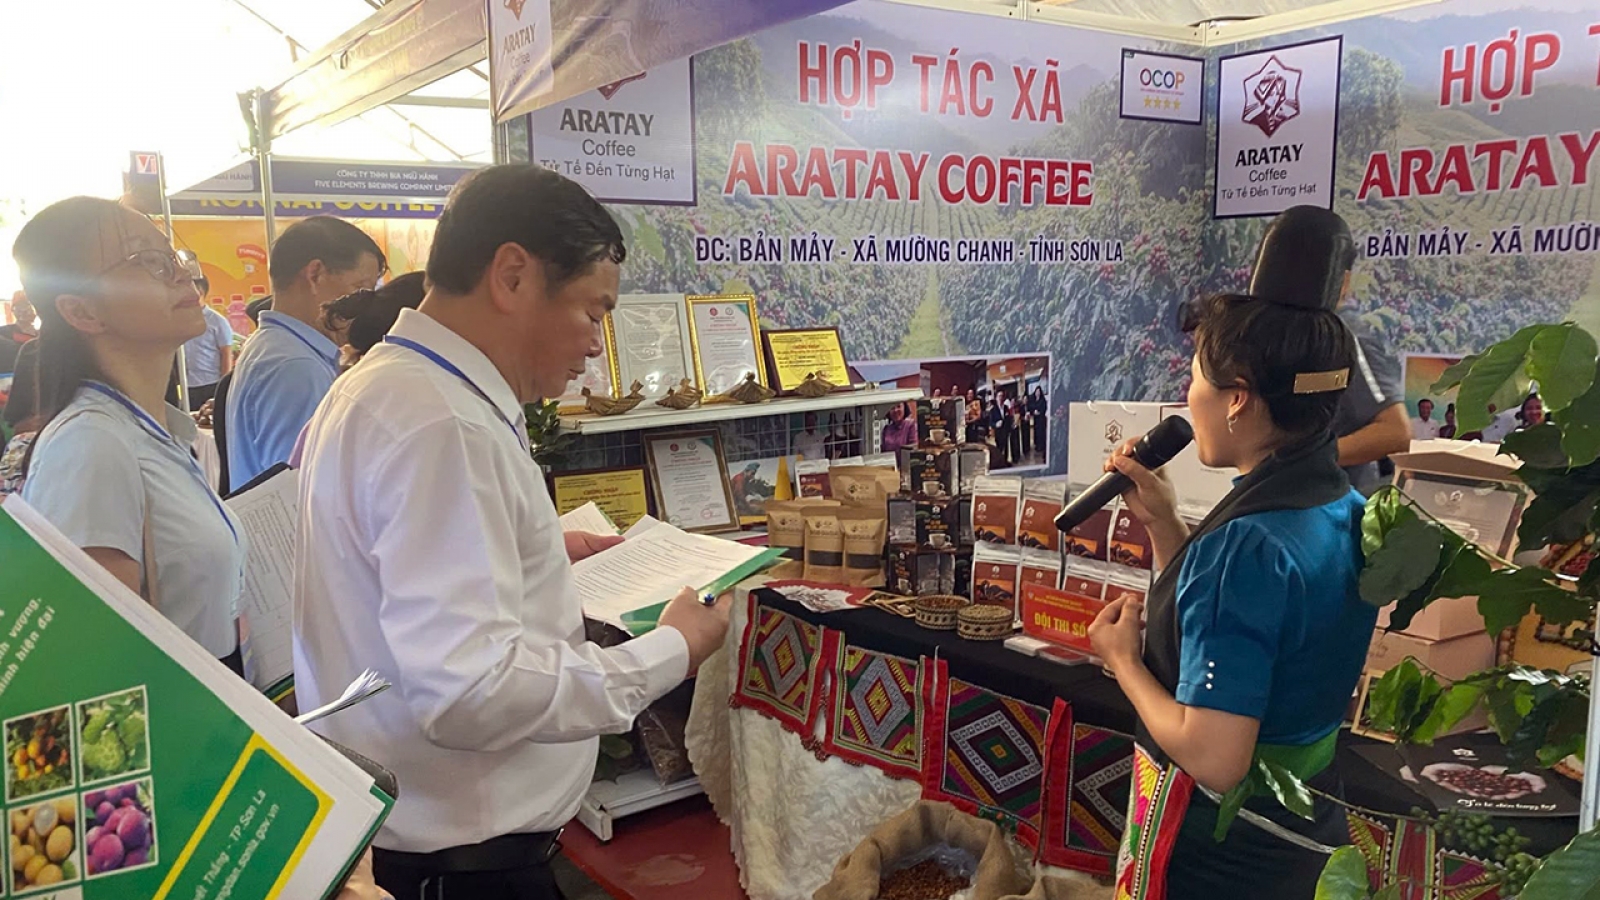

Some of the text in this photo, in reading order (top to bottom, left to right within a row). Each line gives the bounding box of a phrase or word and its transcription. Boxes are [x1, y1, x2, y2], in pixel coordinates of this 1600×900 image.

[503, 22, 535, 55] ARATAY
[798, 39, 1065, 124] HỢP TÁC XÃ
[1140, 68, 1185, 89] OCOP
[1440, 29, 1561, 113] HỢP
[560, 108, 654, 136] ARATAY
[582, 138, 636, 157] Coffee
[1235, 143, 1304, 167] ARATAY
[564, 158, 582, 175] Tế
[585, 161, 612, 176] Đến
[616, 163, 649, 181] Từng
[653, 166, 675, 182] Hạt
[724, 142, 1093, 206] ARATAY COFFEE
[1249, 168, 1287, 182] Coffee
[1358, 131, 1600, 199] ARATAY
[314, 180, 330, 188] FIVE
[332, 181, 366, 189] ELEMENTS
[368, 182, 398, 190] BREWING
[400, 182, 433, 190] COMPANY
[1250, 185, 1269, 197] Đến
[1271, 184, 1296, 197] Từng
[1299, 183, 1316, 195] Hạt
[696, 237, 731, 262] ĐC:
[740, 230, 781, 262] BẢN
[791, 231, 834, 262] MẢY
[853, 235, 878, 262] XÃ
[886, 235, 950, 262] MƯỜNG
[957, 240, 1013, 262] CHANH
[1030, 235, 1064, 262] TỈNH
[1070, 237, 1100, 261] SƠN
[1105, 240, 1123, 261] LA
[1367, 229, 1410, 257] BẢN
[1418, 226, 1469, 256] MẢY
[1490, 226, 1522, 254] XÃ
[1034, 611, 1086, 638] ĐỘI THI SỐ
[15, 631, 39, 662] hiện
